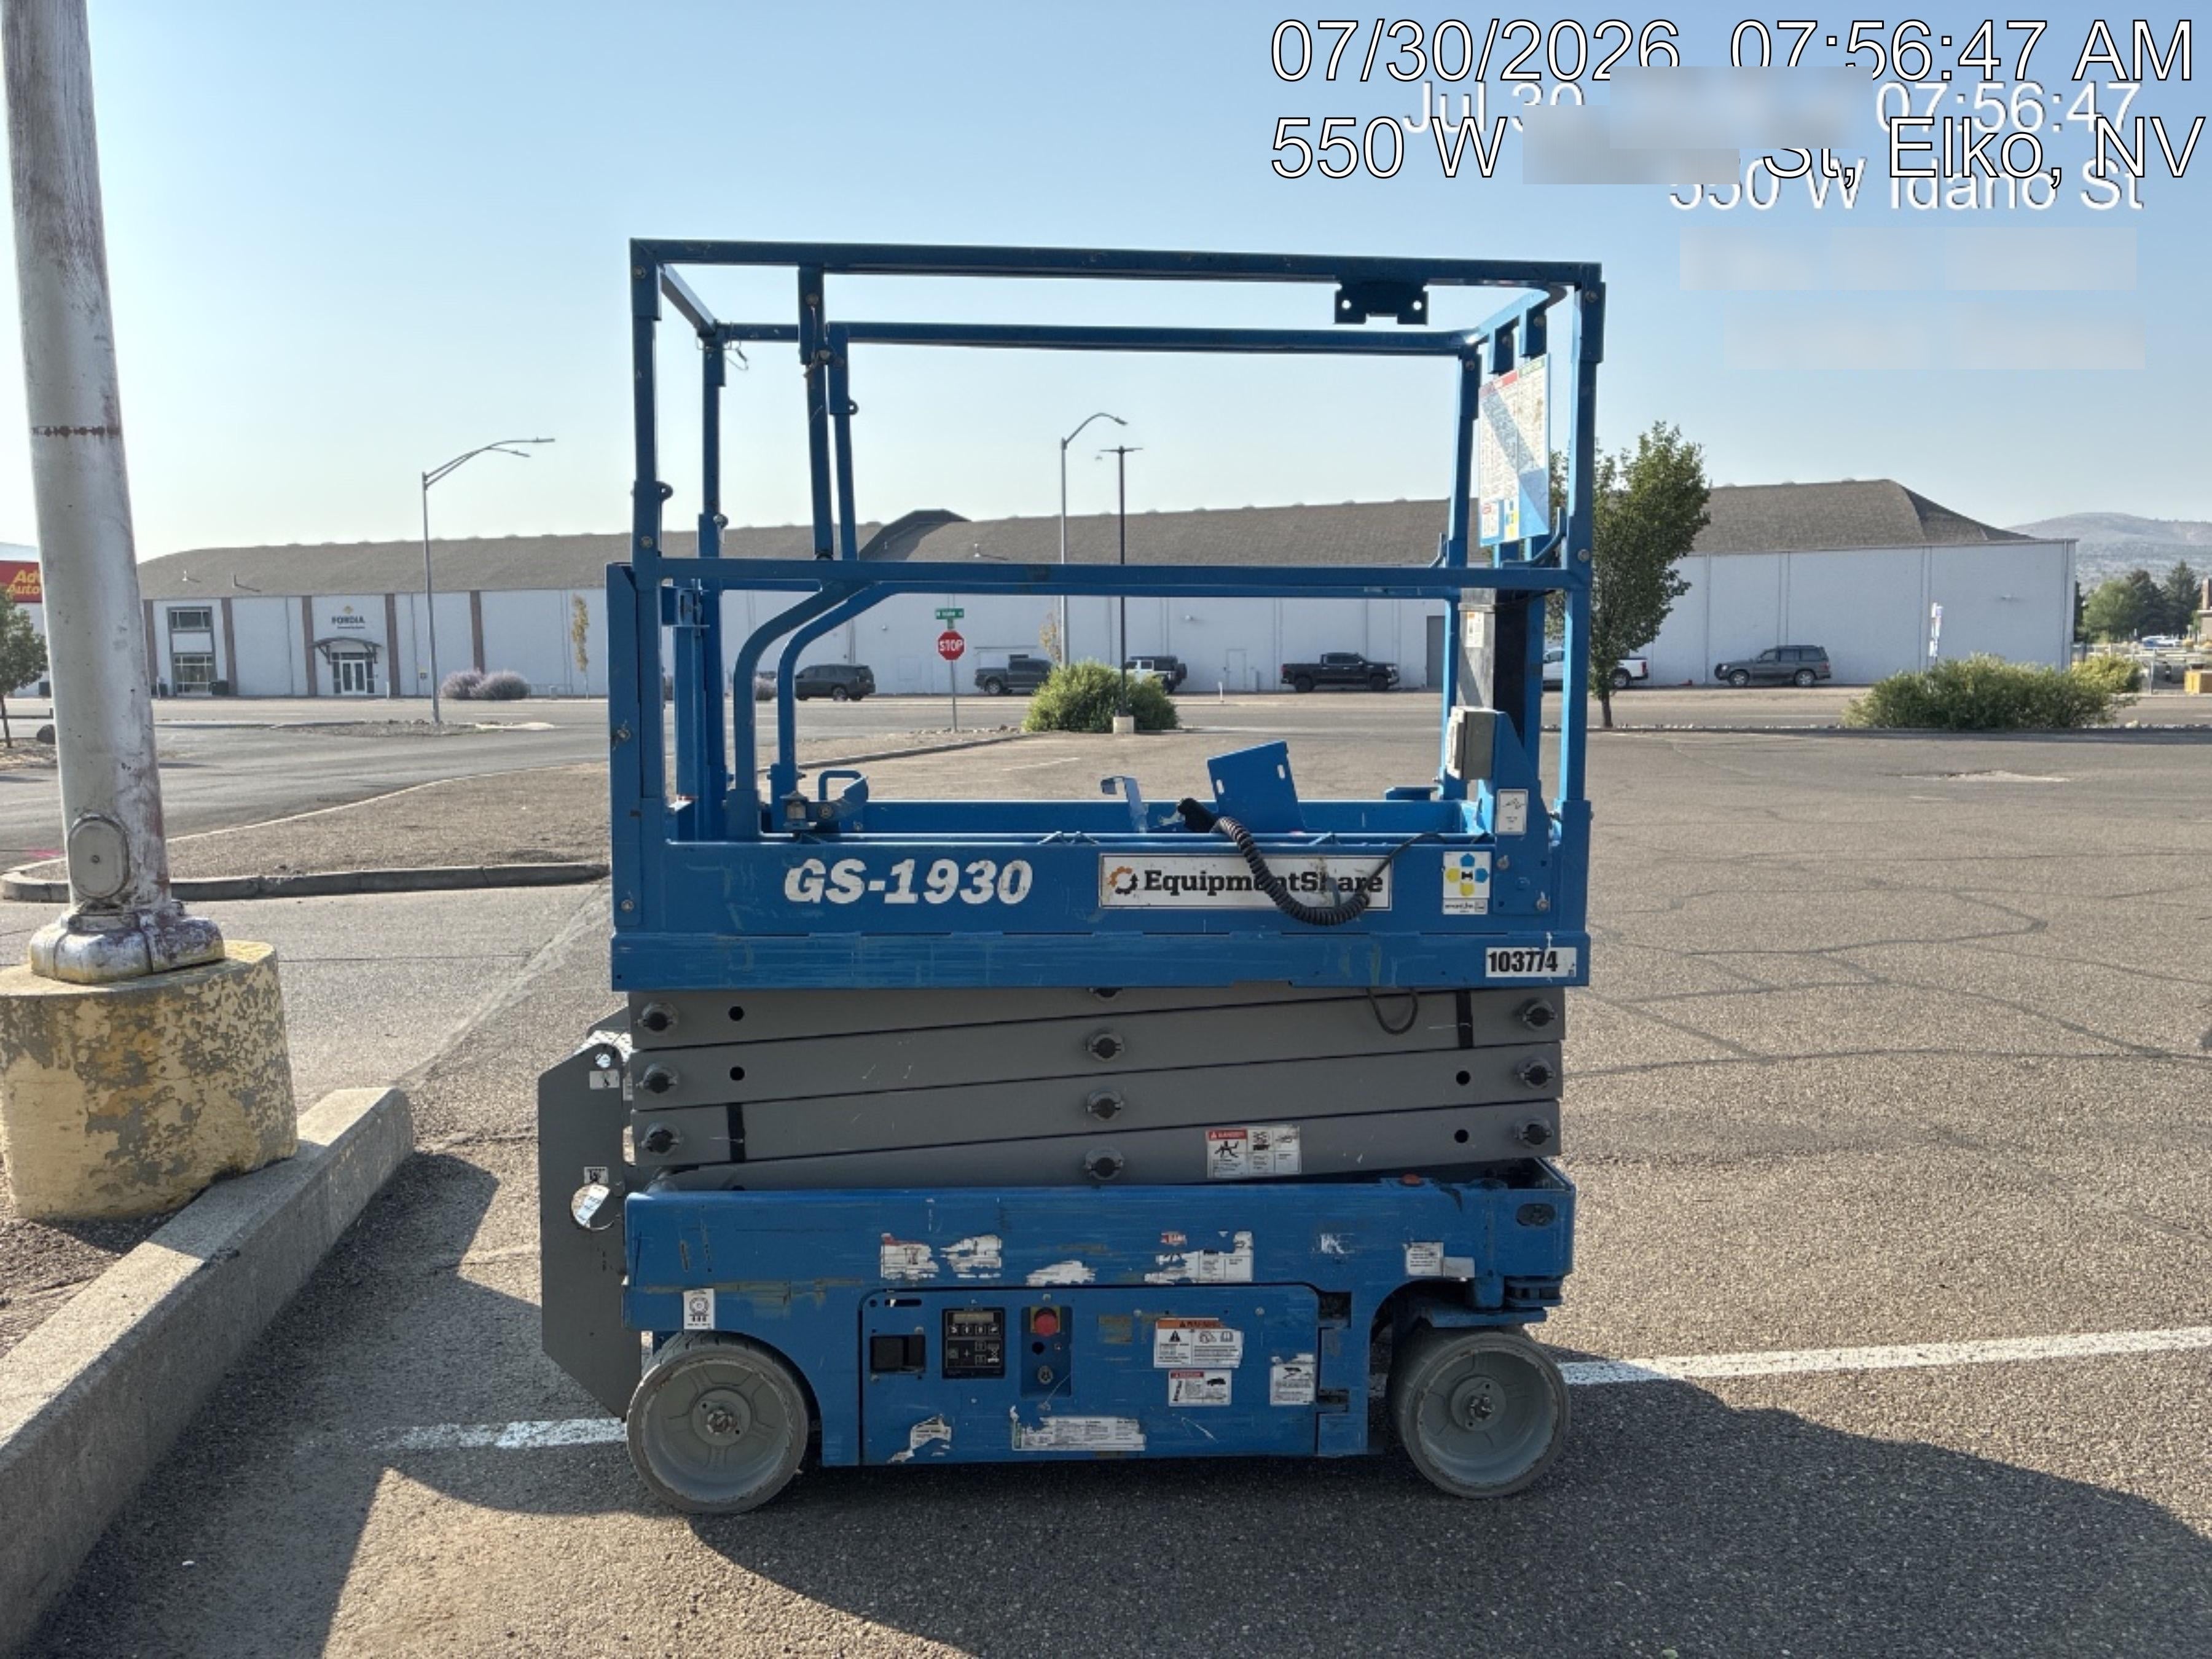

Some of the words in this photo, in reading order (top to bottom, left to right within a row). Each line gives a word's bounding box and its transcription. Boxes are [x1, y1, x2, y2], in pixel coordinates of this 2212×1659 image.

[939, 640, 963, 651] STOP
[784, 858, 1033, 904] GS-1930
[1488, 951, 1558, 971] 103774
